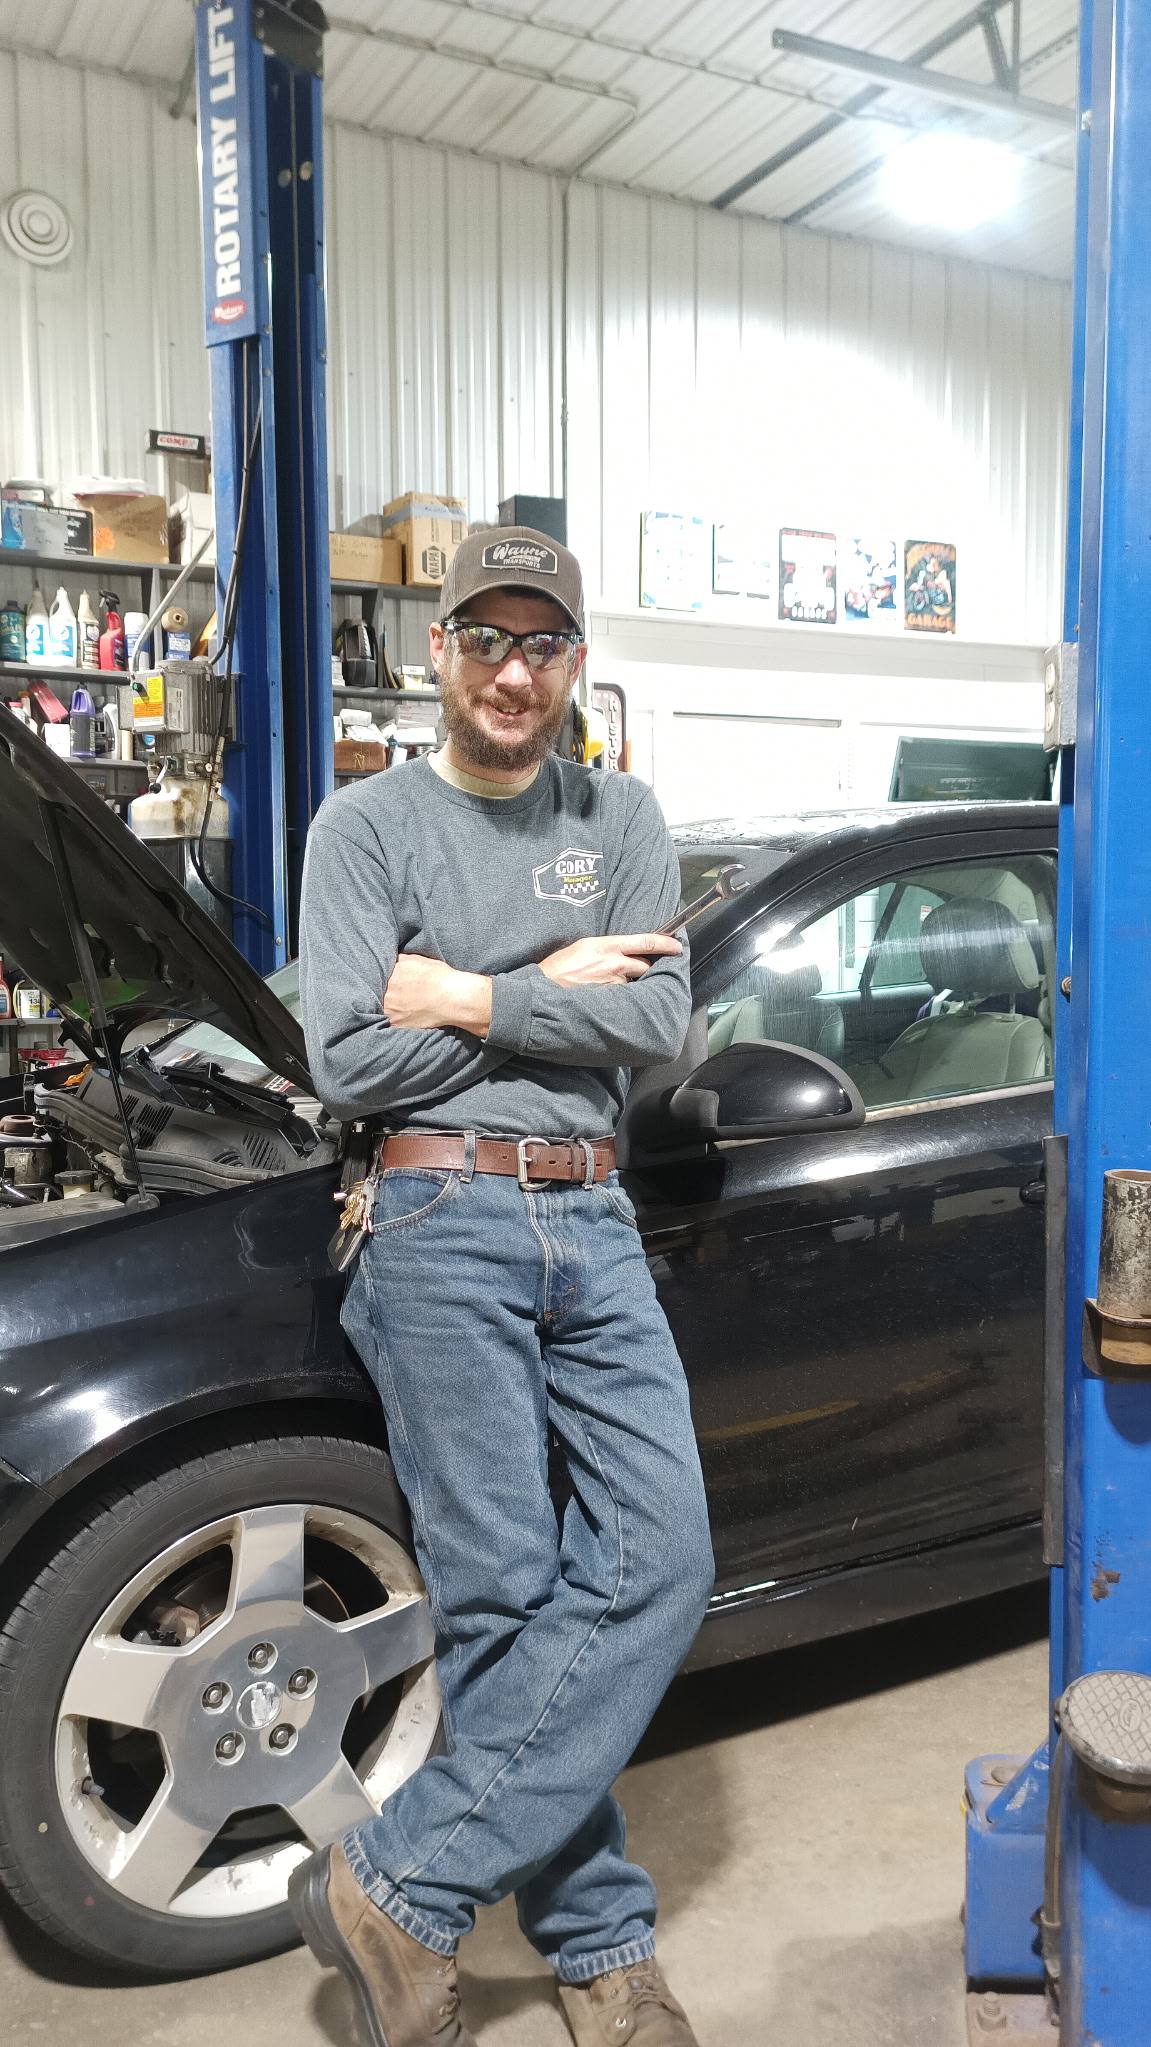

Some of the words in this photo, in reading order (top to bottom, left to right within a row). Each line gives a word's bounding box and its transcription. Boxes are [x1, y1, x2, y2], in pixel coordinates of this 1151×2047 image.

[208, 8, 236, 104] LIFT
[210, 117, 242, 298] ROTARY
[428, 550, 441, 574] NAPA
[492, 543, 549, 561] Wayne
[503, 558, 541, 569] TRANSPORTS
[555, 857, 597, 874] CORY
